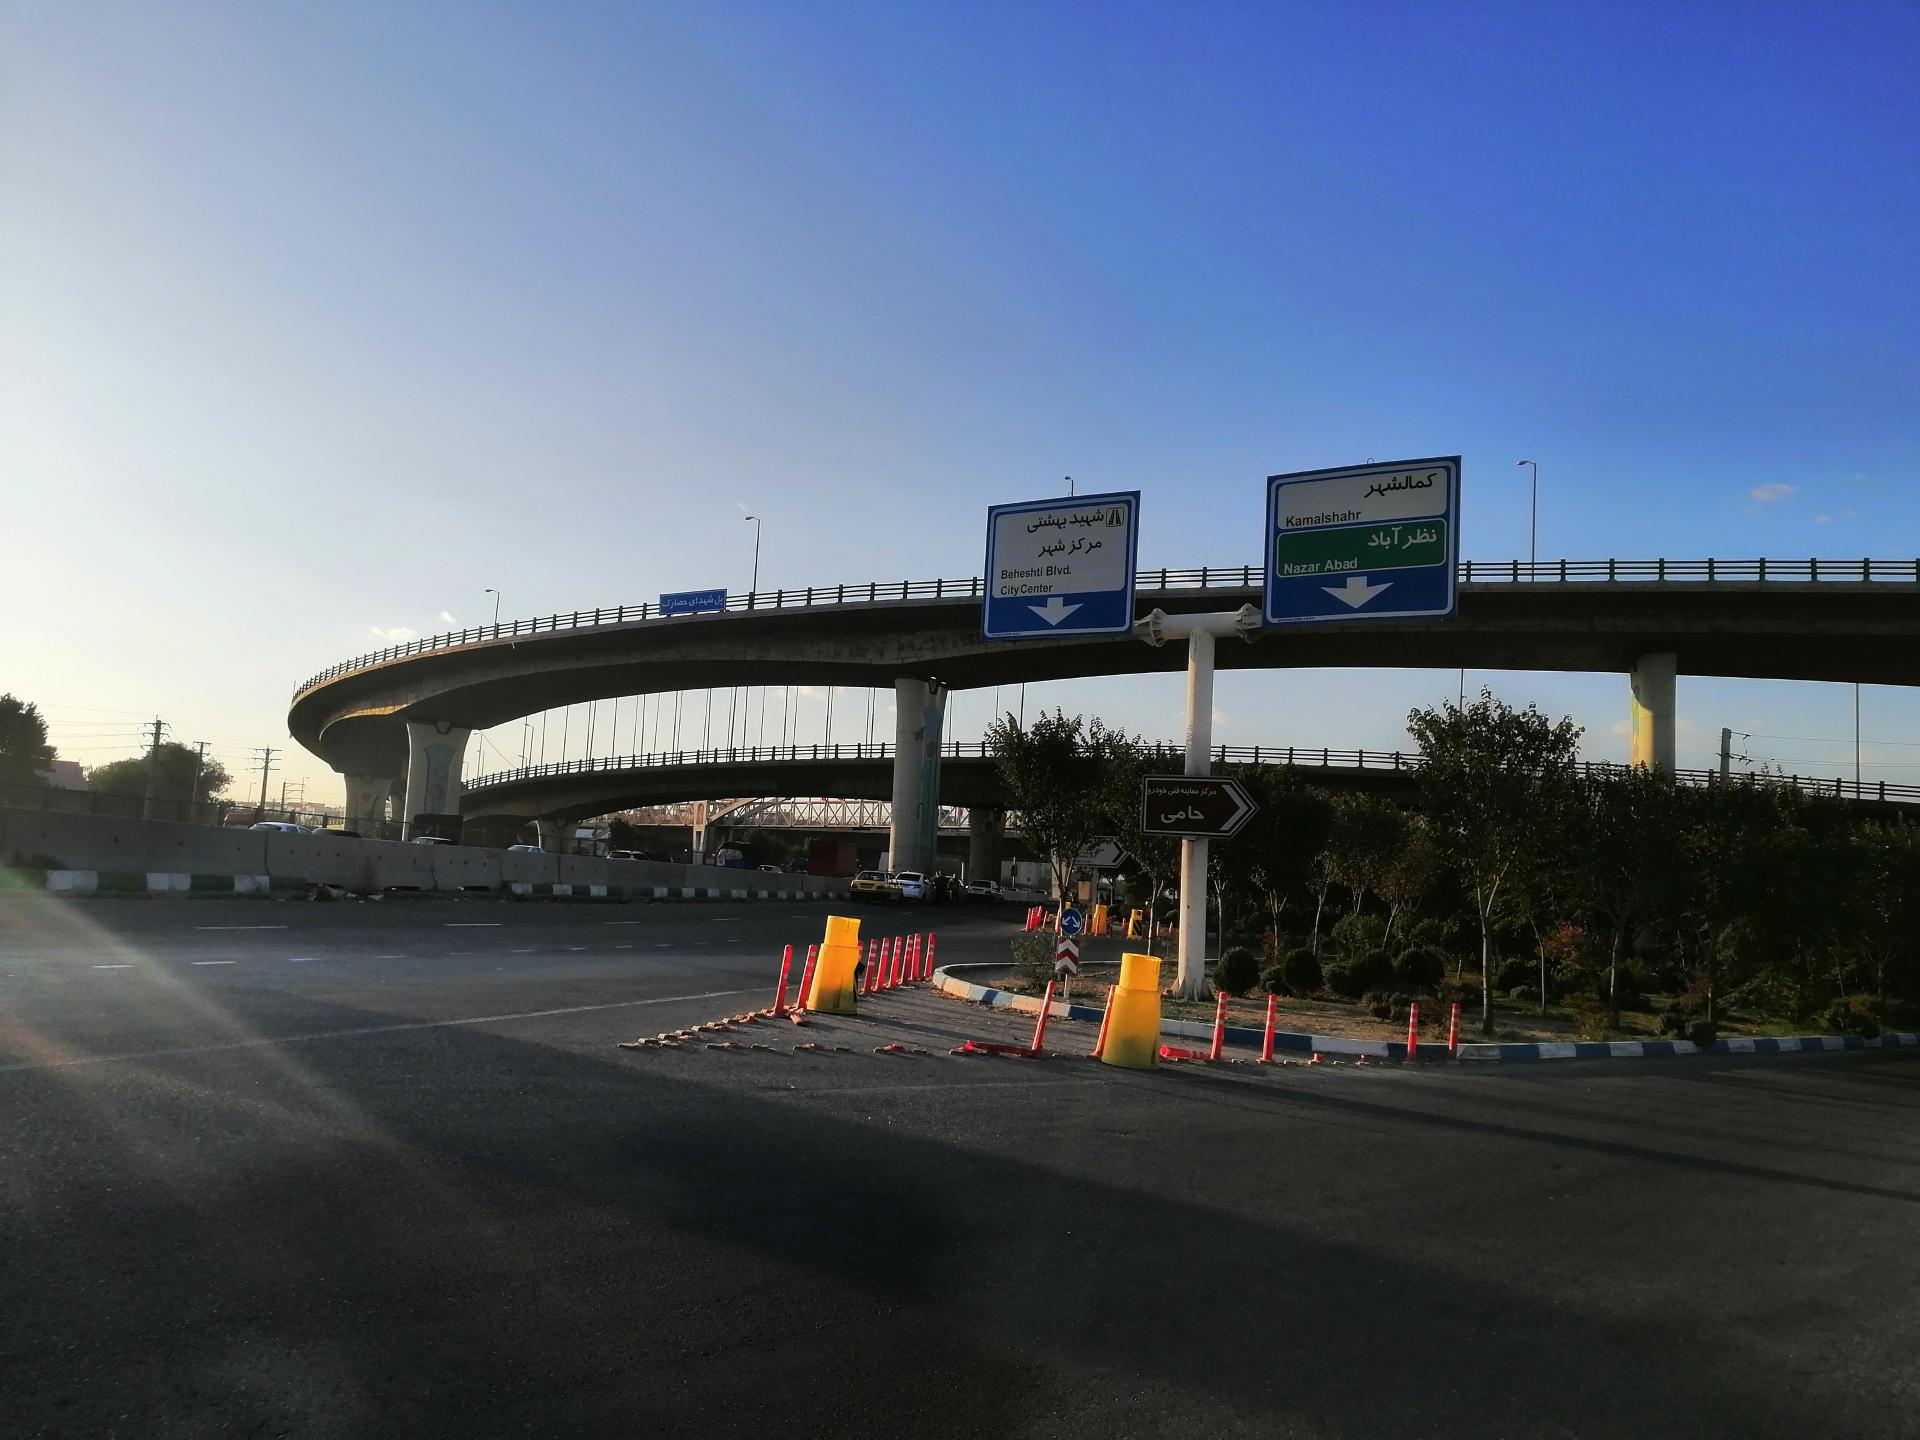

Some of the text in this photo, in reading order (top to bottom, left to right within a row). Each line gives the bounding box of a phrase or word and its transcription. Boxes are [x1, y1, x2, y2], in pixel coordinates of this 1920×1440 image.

[1364, 472, 1438, 498] کمالشهر
[1027, 509, 1105, 533] شهید بهشتی
[1286, 509, 1362, 528] Kamalshahr
[1367, 526, 1437, 549] نظر آباد
[1038, 537, 1102, 558] مرکز شهر
[1001, 564, 1072, 580] Beheshti Blvd.
[1284, 557, 1358, 575] Nazar Abad
[1001, 583, 1053, 597] City Center
[1147, 785, 1167, 796] خودرو
[1167, 785, 1180, 796] فنی
[1199, 787, 1217, 797] مرکز
[1160, 805, 1204, 824] حامی
